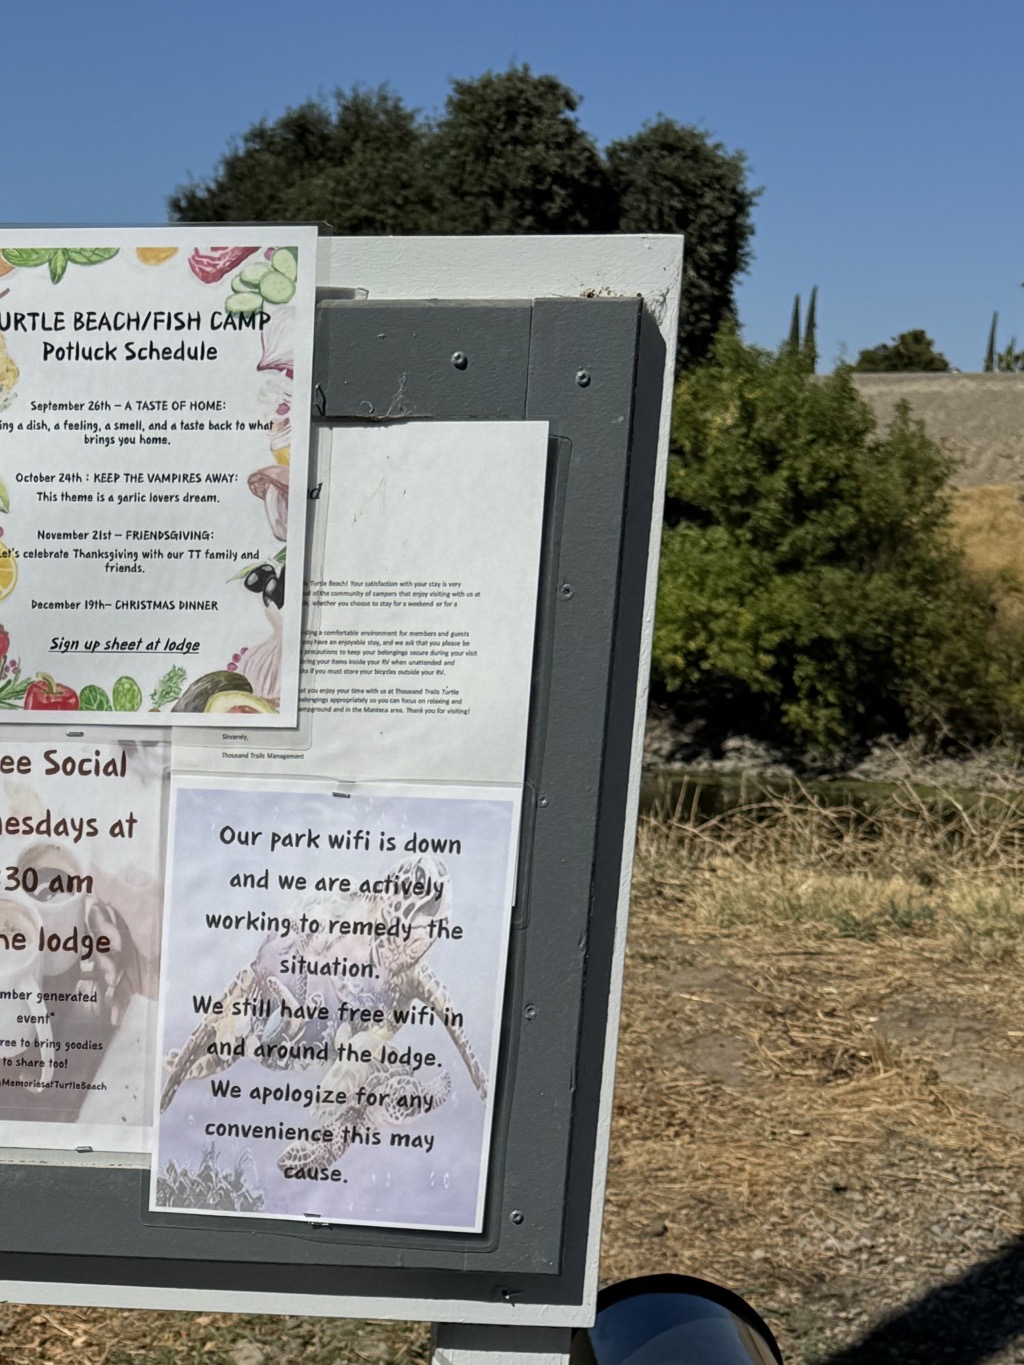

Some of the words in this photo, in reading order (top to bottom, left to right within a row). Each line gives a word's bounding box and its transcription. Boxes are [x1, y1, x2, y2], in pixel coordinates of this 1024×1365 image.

[74, 311, 201, 332] BEACH/FISH
[210, 311, 271, 331] CAMP
[43, 342, 117, 361] Potluck
[125, 342, 217, 361] Schedule
[31, 600, 81, 610] December
[115, 600, 175, 610] CHRISTMAS
[179, 601, 218, 611] DINNER
[50, 637, 79, 652] Sign
[84, 639, 100, 652] up
[104, 638, 142, 651] sheet
[146, 639, 160, 650] at
[164, 639, 200, 654] lodge
[223, 733, 248, 741] Sincerely,
[44, 750, 127, 776] Social
[267, 753, 304, 761] Management
[109, 812, 137, 838] at
[219, 826, 262, 846] Our
[271, 829, 320, 852] park
[329, 830, 370, 850] wifi
[379, 832, 396, 851] is
[404, 832, 461, 855] down
[49, 875, 92, 894] am
[229, 871, 269, 889] and
[278, 874, 306, 890] we
[315, 875, 351, 892] are
[359, 876, 444, 898] actively
[39, 927, 110, 959] lodge
[280, 957, 380, 978] situation.
[284, 1166, 347, 1183] cause.
